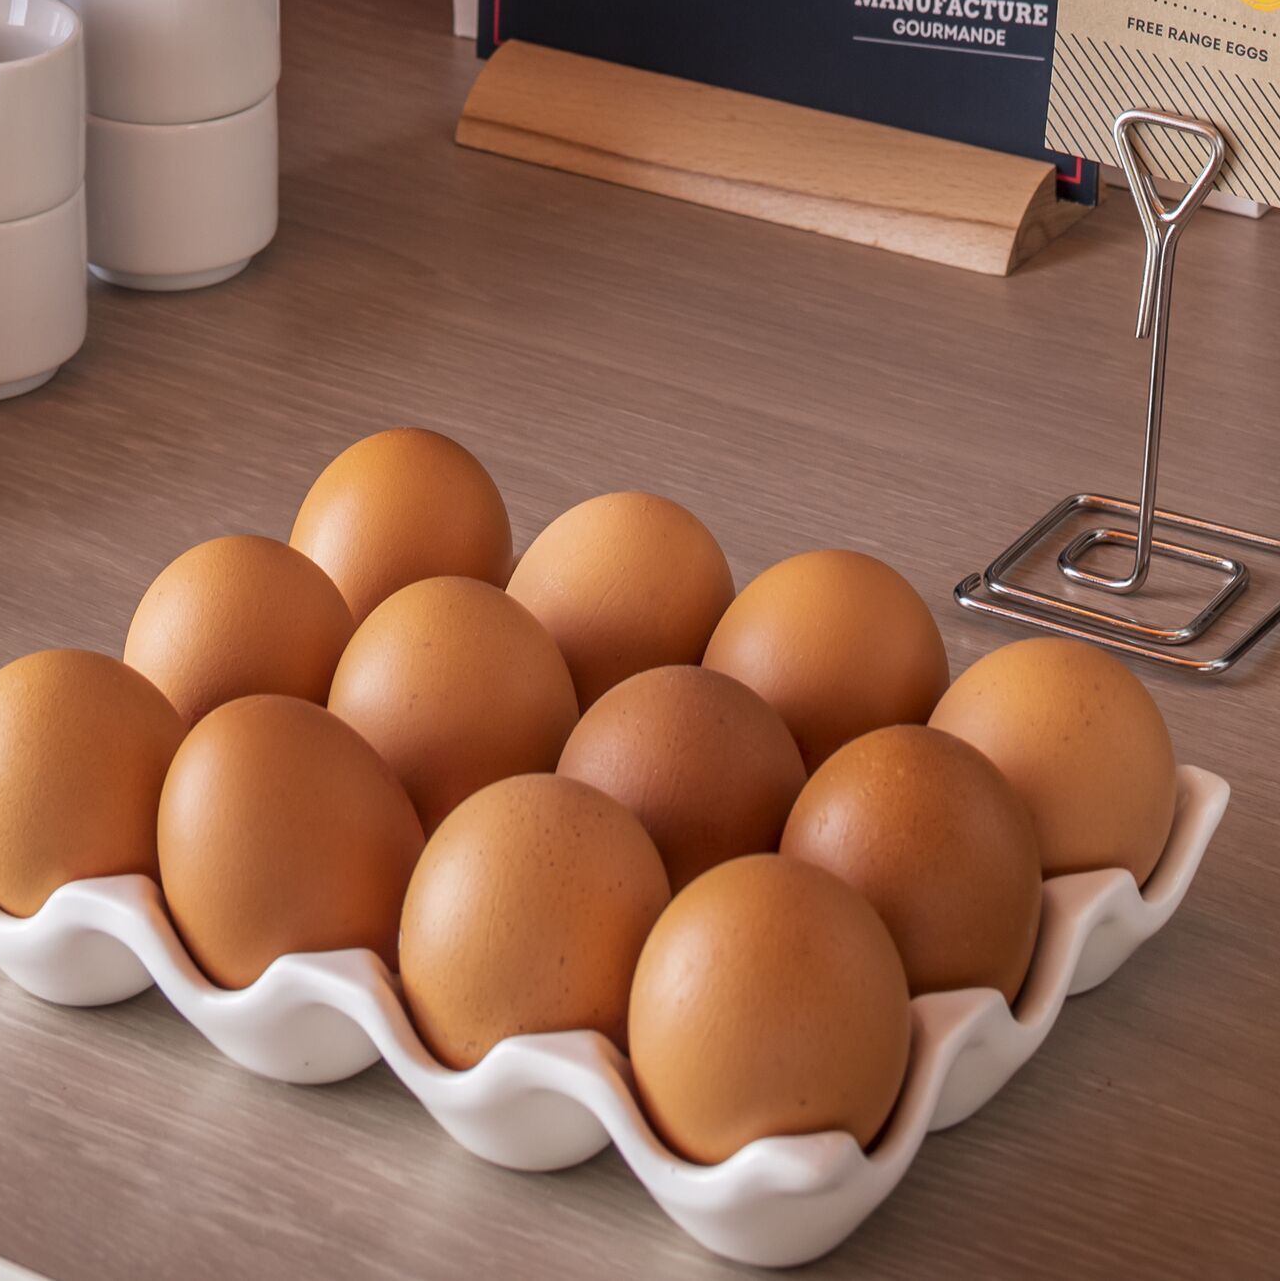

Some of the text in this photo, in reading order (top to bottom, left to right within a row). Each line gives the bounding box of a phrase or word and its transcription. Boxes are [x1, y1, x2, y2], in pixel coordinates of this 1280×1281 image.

[892, 18, 1006, 47] GOURMANDE
[1127, 17, 1269, 62] FREE RANGE EGGS
